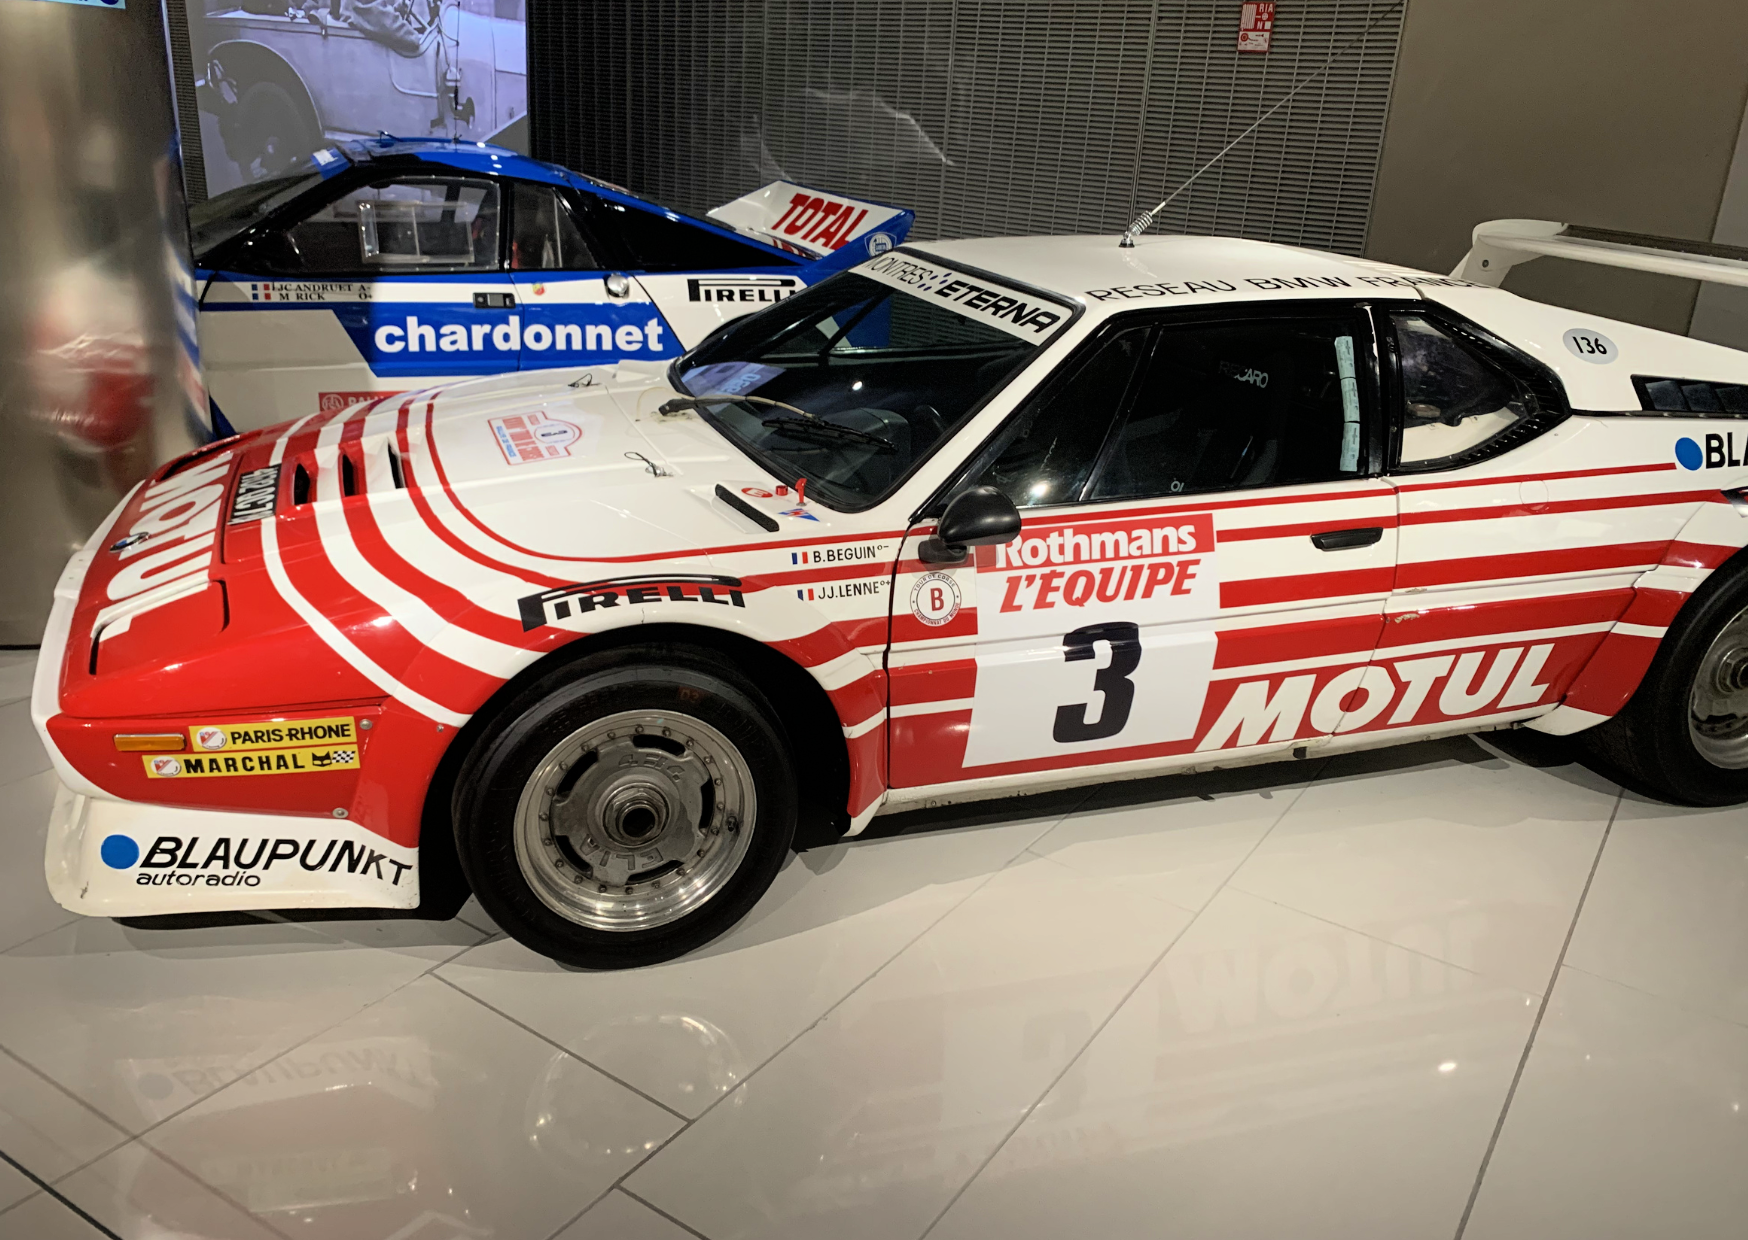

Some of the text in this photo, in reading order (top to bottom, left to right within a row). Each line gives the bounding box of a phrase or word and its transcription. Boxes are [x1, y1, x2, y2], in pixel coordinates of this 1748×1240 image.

[771, 192, 869, 250] TOTAL
[279, 293, 289, 301] M
[295, 293, 325, 301] RICK
[295, 283, 354, 292] ANDRUET
[863, 256, 1061, 333] MONTRES ETERNA
[1084, 279, 1237, 301] RESEAU
[1243, 276, 1352, 290] BMW
[374, 315, 663, 352] chardonnet
[1572, 336, 1607, 355] 136
[1705, 431, 1748, 469] BL
[90, 452, 233, 643] MOTUL
[813, 546, 876, 563] B.BEGUIN
[995, 524, 1197, 568] Rothmans
[517, 573, 746, 633] PIRELLI
[818, 581, 879, 600] JJ.LENNE
[930, 587, 944, 612] B
[1052, 621, 1143, 744] 3
[1193, 643, 1555, 752] MOTUL
[230, 723, 352, 745] PARIS-RHONE
[184, 752, 305, 774] MARCHAL
[139, 836, 414, 886] BLAUPUNKT
[136, 869, 262, 887] autoradio
